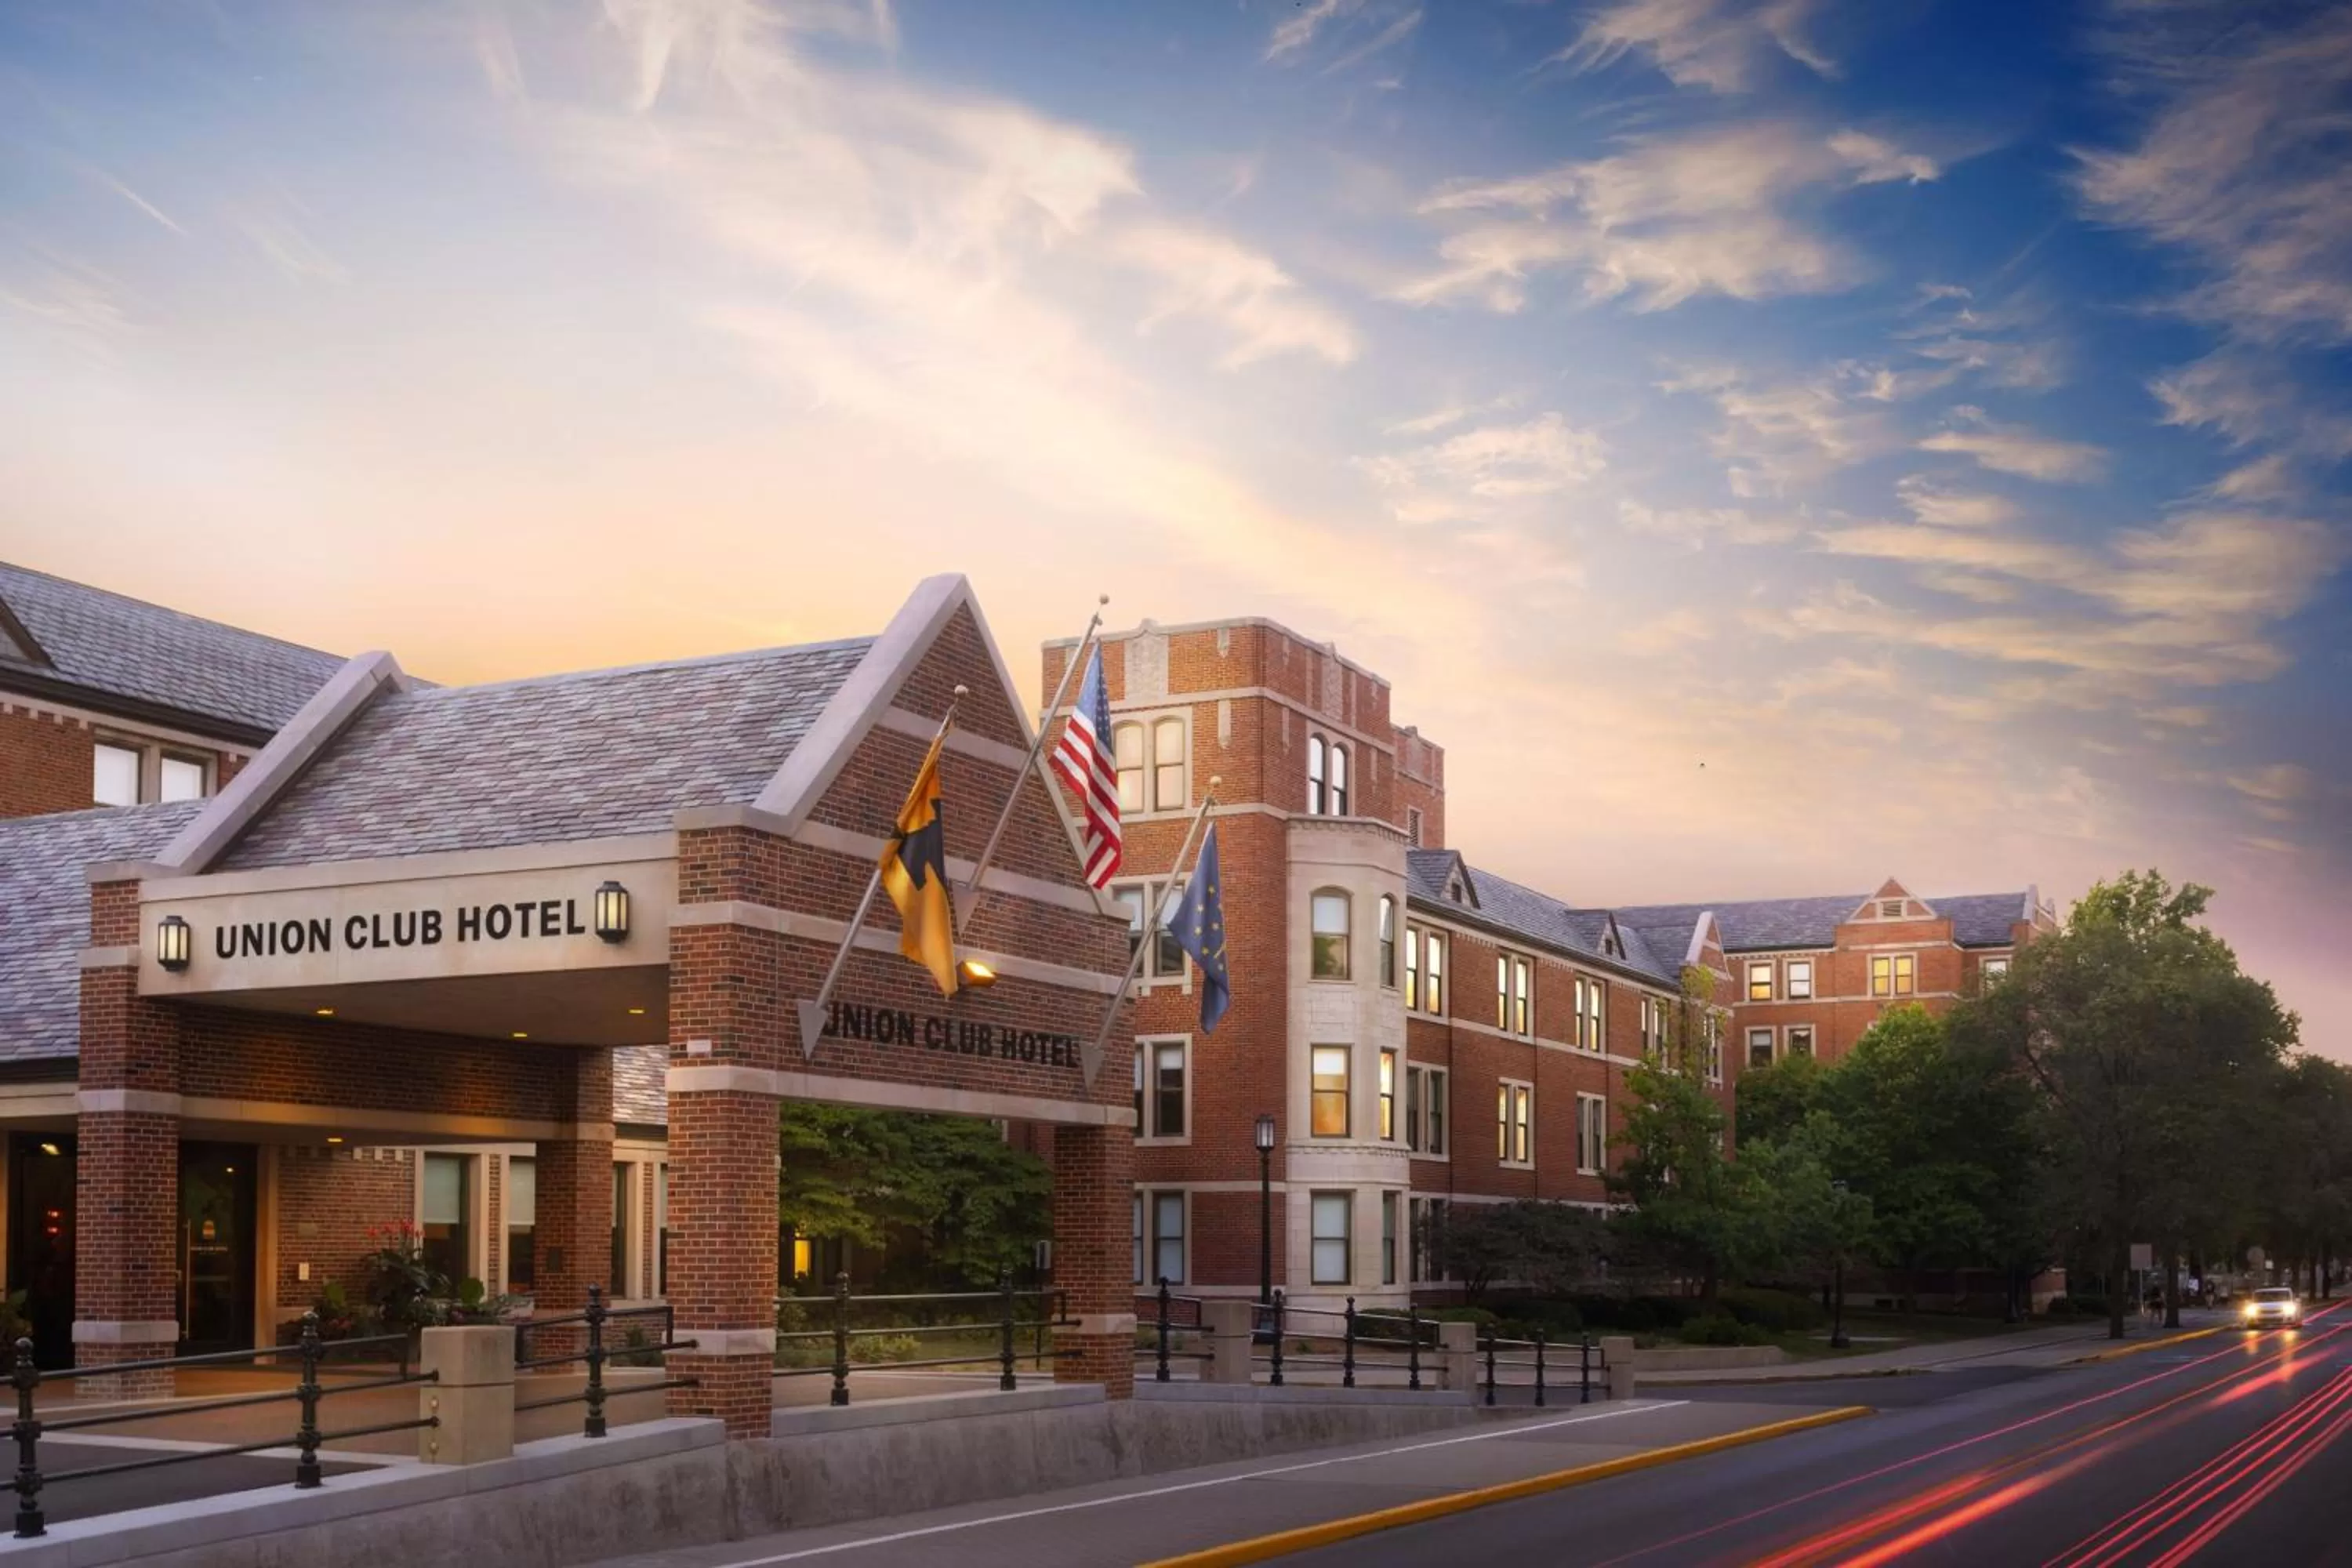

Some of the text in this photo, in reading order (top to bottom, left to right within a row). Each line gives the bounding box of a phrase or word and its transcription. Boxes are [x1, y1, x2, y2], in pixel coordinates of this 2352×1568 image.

[216, 899, 586, 959] UNION CLUB HOTEL
[924, 1015, 993, 1056] CLUB
[1001, 1028, 1081, 1068] HOTEL
